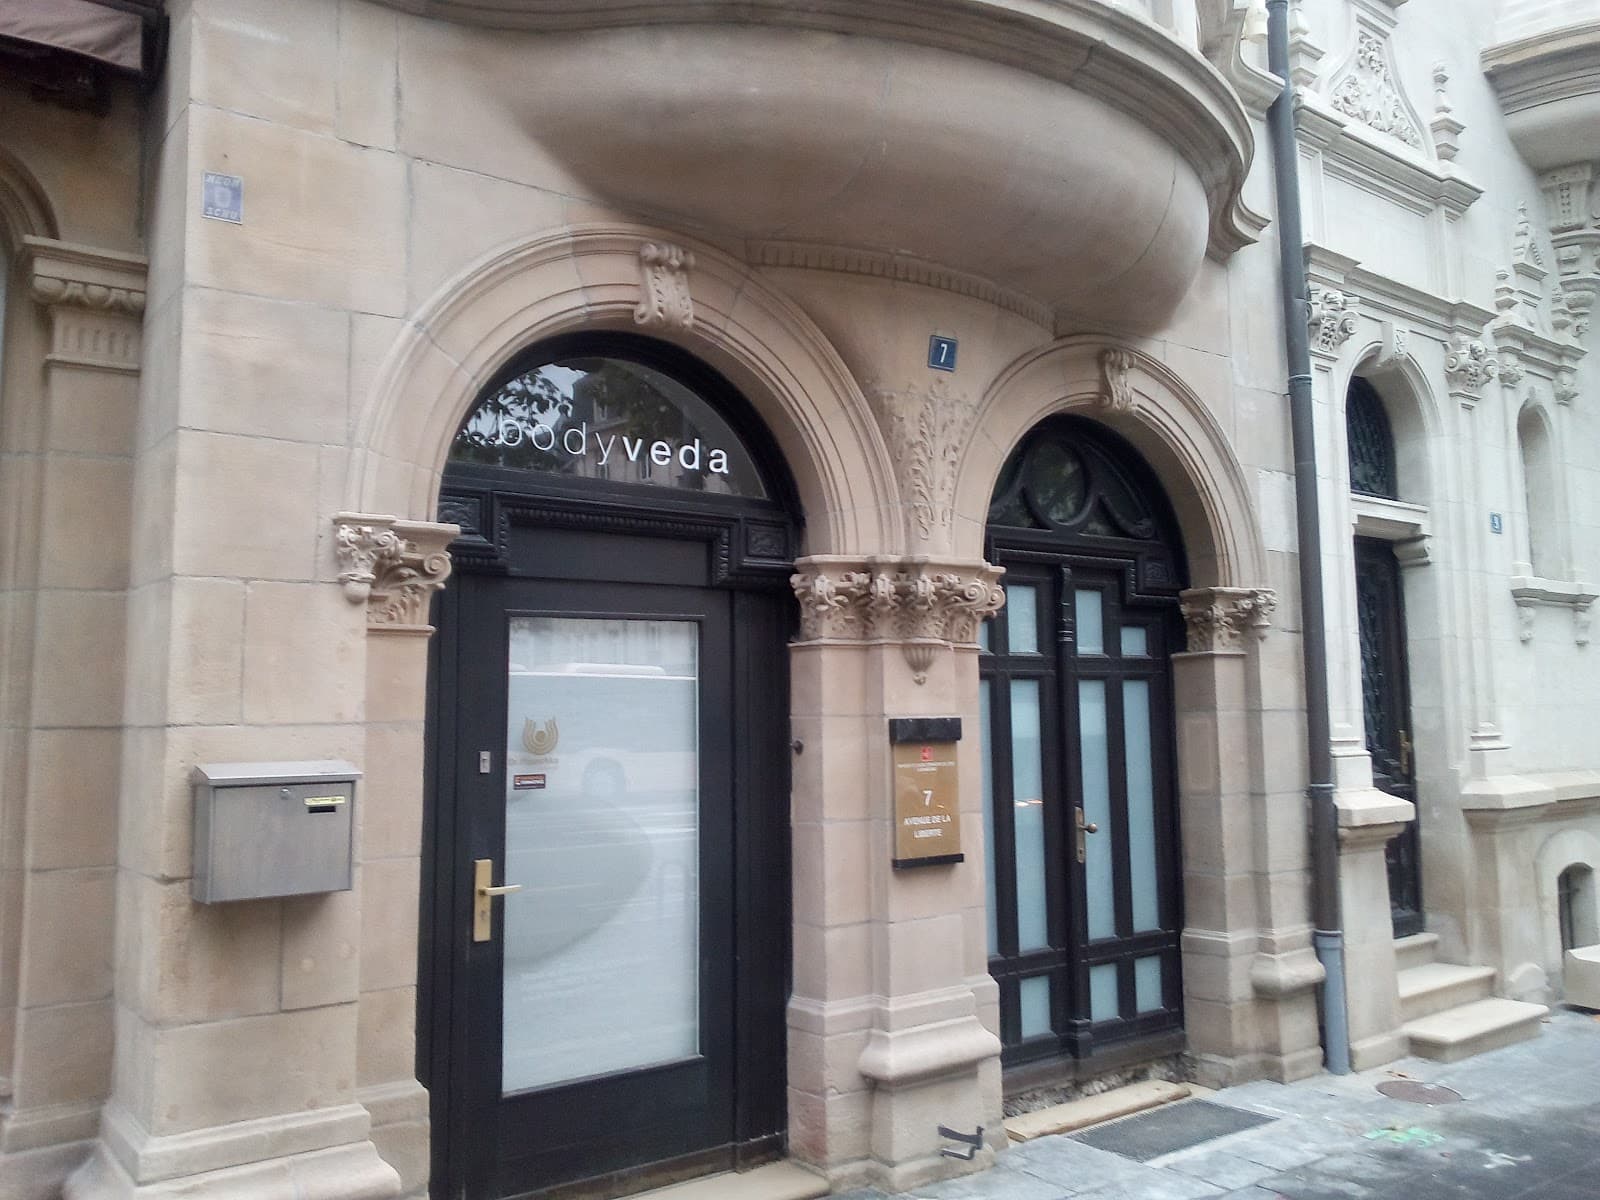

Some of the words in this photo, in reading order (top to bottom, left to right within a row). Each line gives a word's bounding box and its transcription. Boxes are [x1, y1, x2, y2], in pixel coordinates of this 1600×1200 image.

[940, 343, 948, 363] 7
[498, 409, 729, 474] bodyveda
[922, 790, 933, 807] 7
